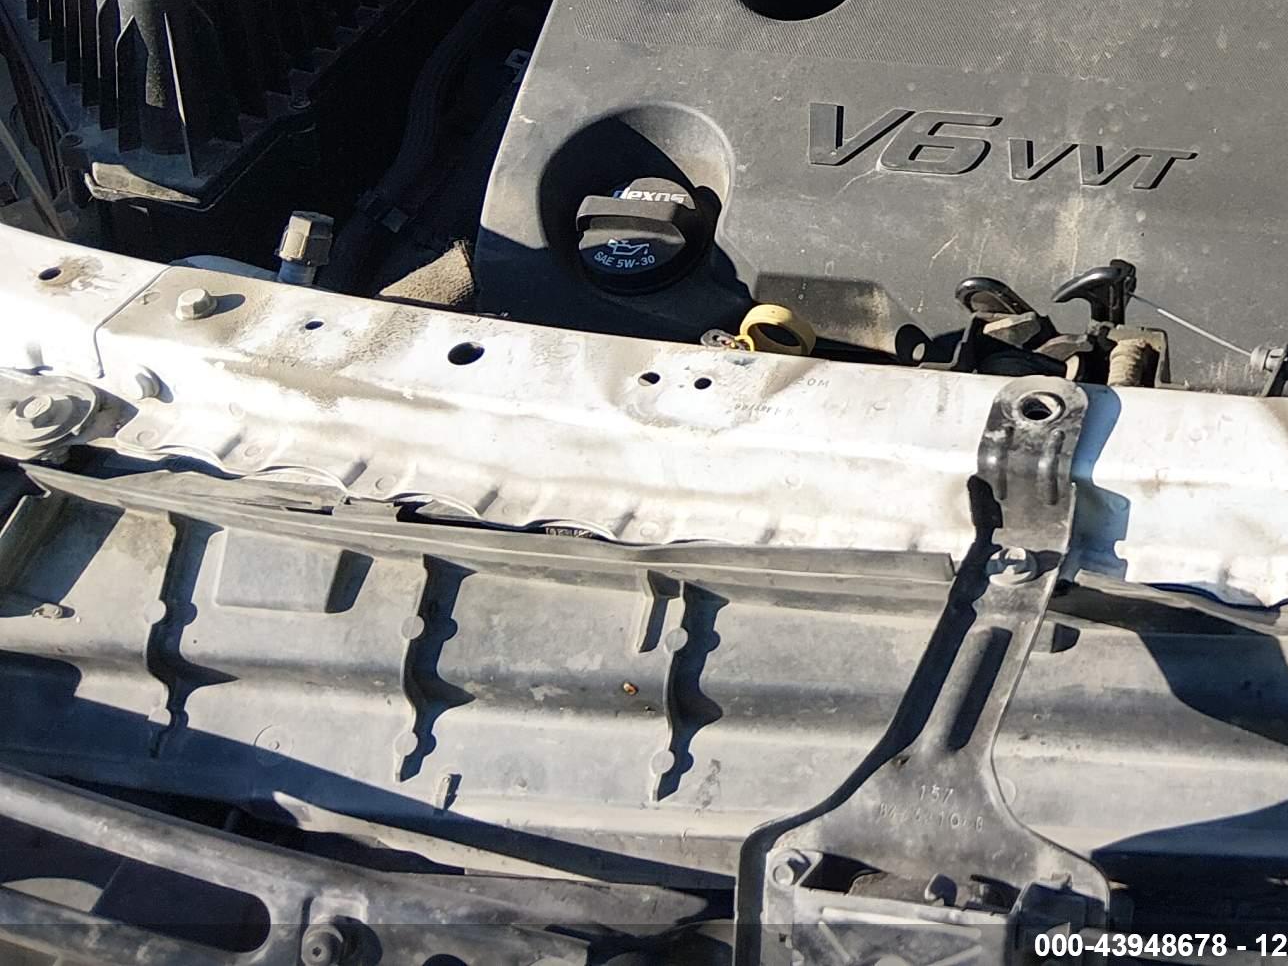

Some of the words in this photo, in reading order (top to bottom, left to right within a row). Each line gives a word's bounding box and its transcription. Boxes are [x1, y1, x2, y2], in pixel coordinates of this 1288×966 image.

[809, 102, 1003, 176] V6
[1007, 137, 1199, 190] VVT
[594, 251, 615, 266] SAE
[616, 254, 655, 268] 5W-30
